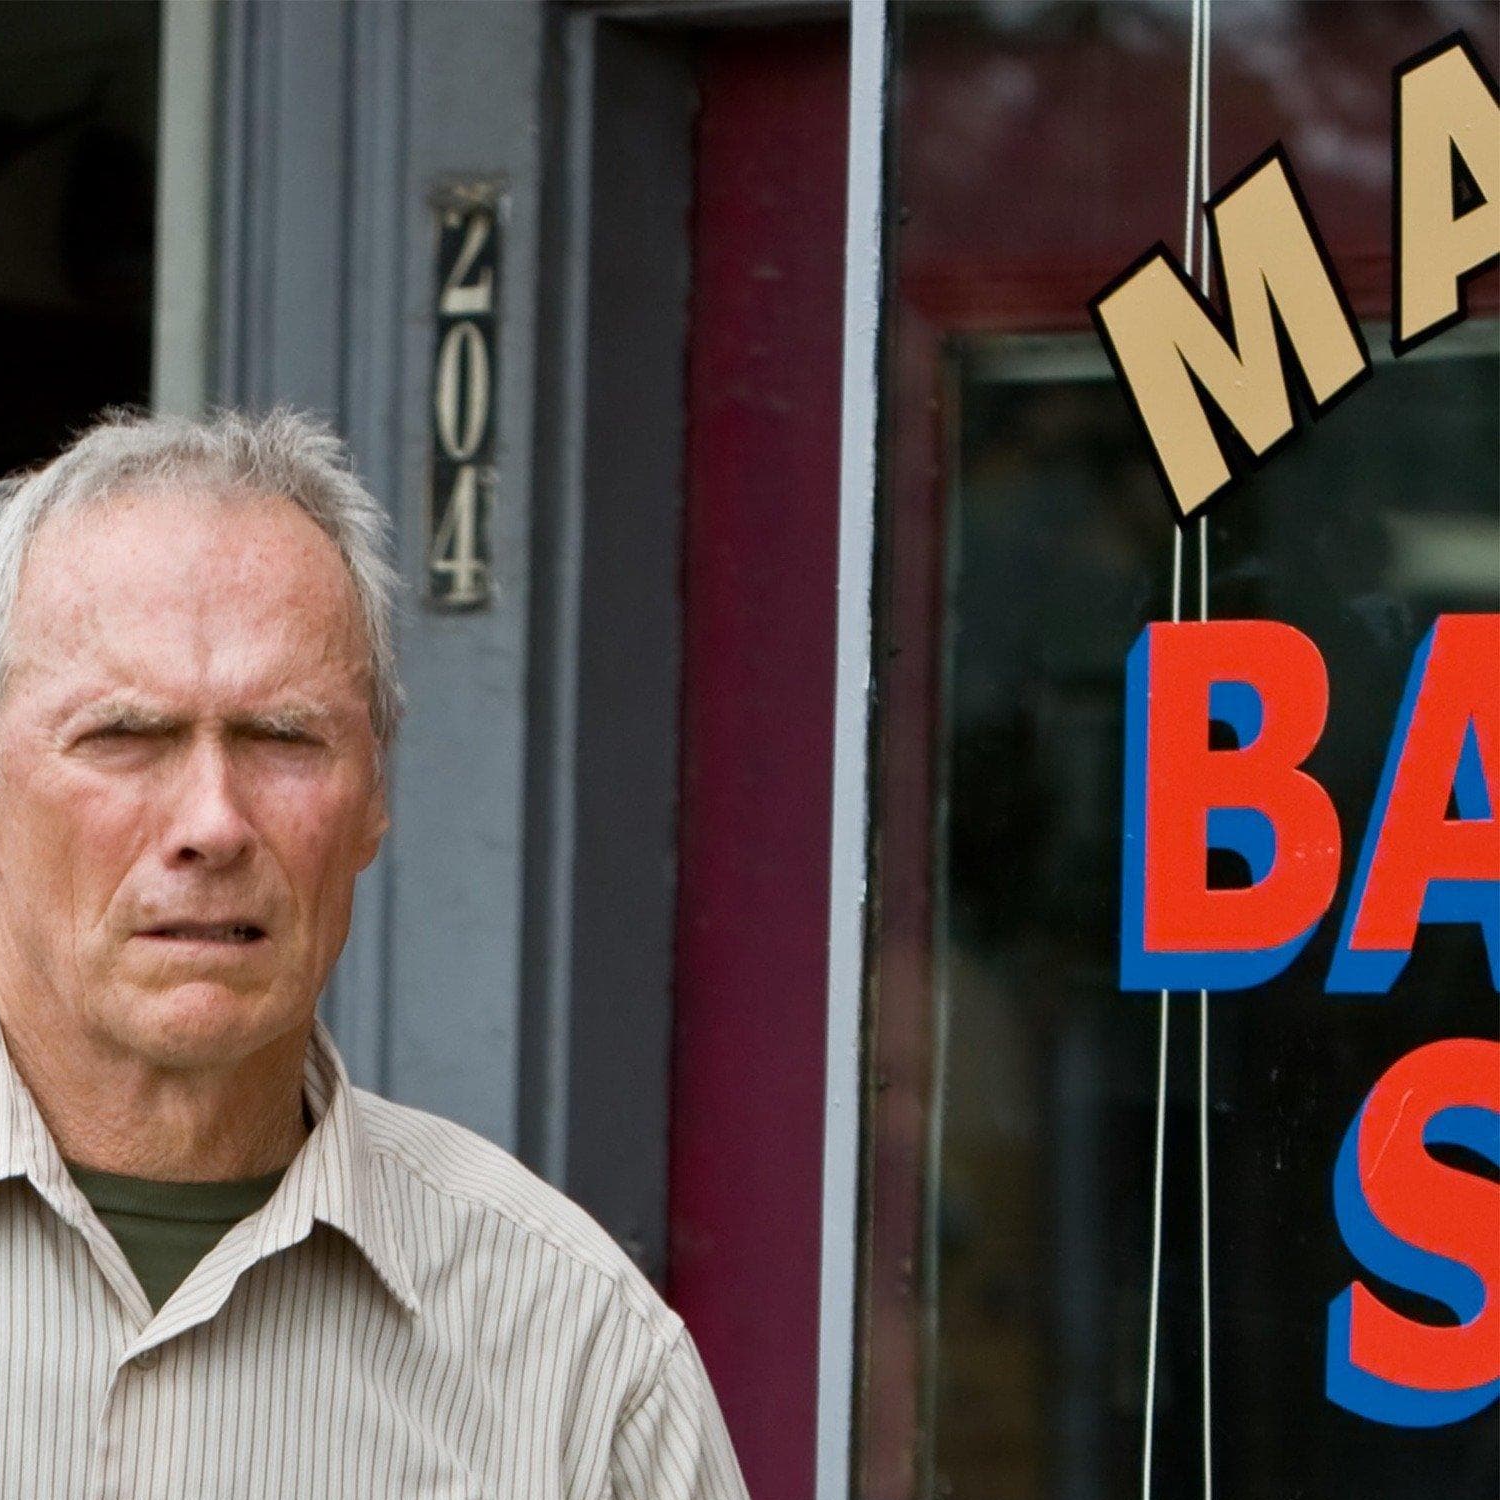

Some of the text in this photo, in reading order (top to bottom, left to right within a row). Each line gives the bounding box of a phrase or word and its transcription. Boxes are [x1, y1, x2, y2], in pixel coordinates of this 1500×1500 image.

[432, 208, 493, 602] 204
[1088, 28, 1500, 532] MA
[1119, 613, 1500, 994] BA
